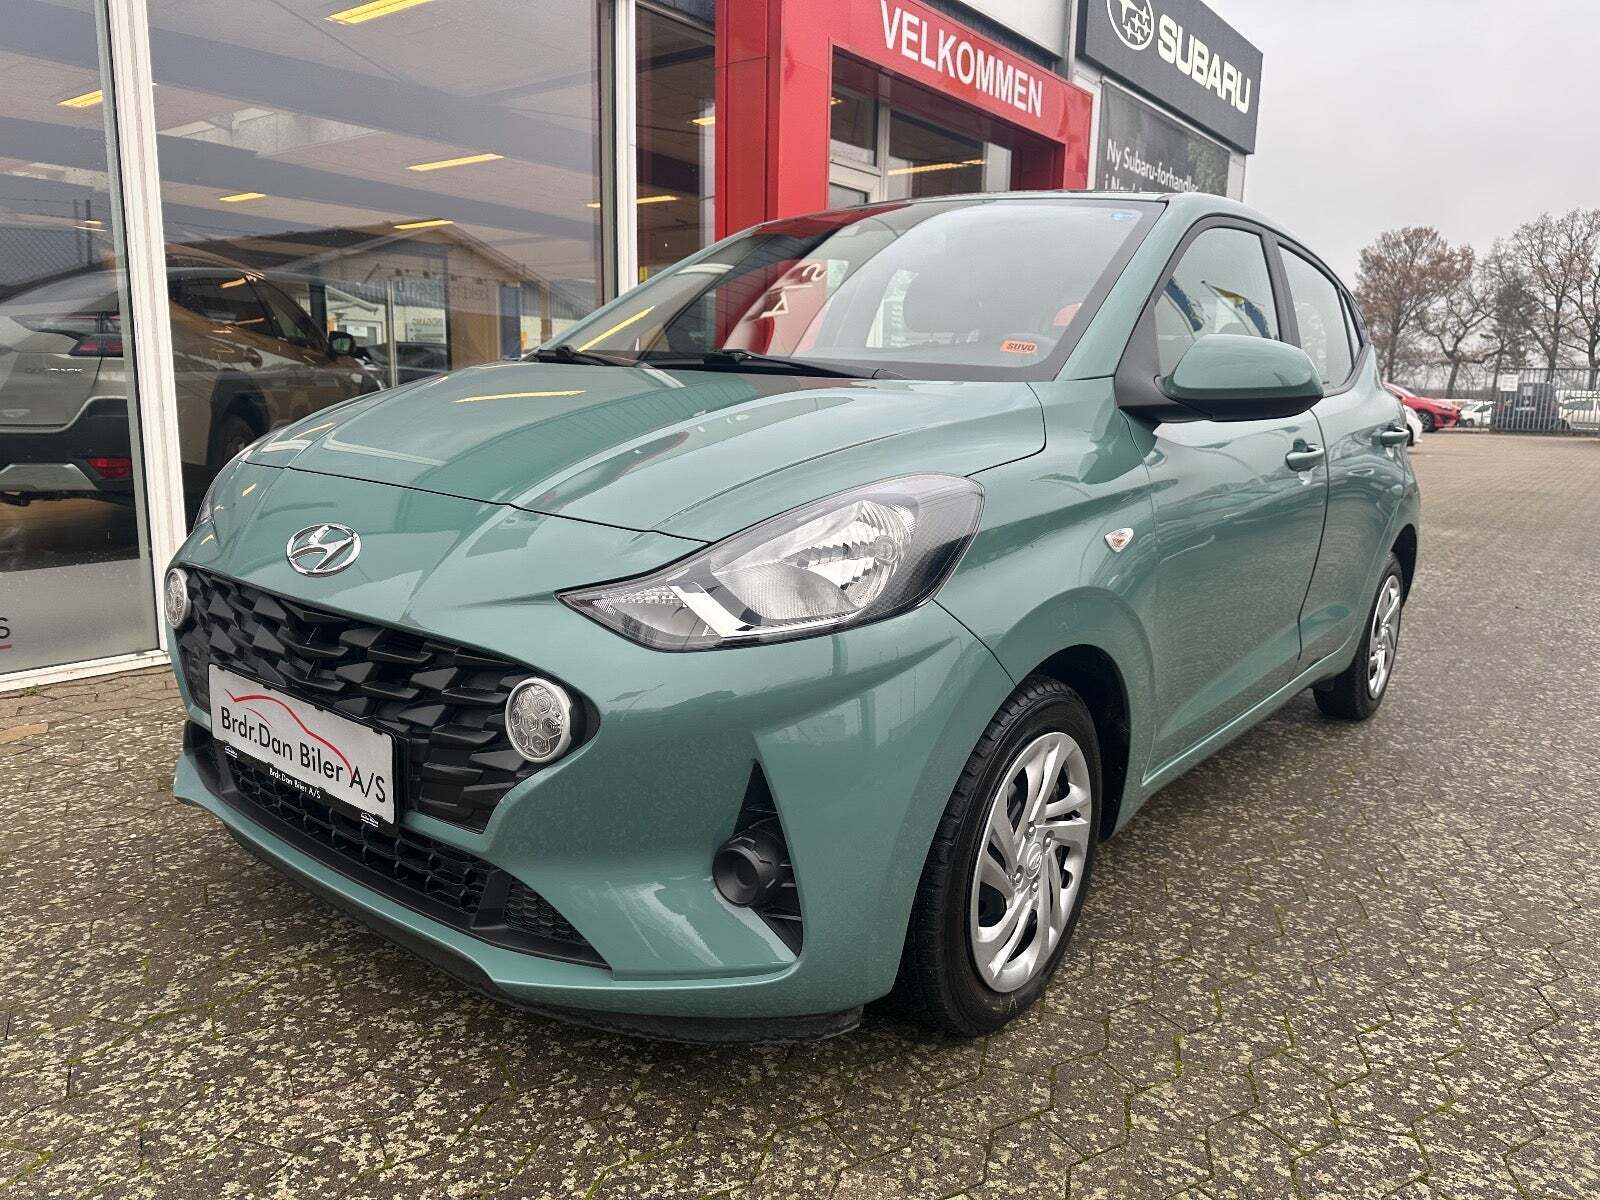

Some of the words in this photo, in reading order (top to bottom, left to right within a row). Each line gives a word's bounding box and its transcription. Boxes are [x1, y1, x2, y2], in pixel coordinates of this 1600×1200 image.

[880, 0, 1043, 118] VELKOMMEN
[1158, 14, 1251, 115] SUBARU
[1106, 138, 1122, 171] Ny
[300, 742, 344, 781] Biler
[349, 765, 386, 803] A/S
